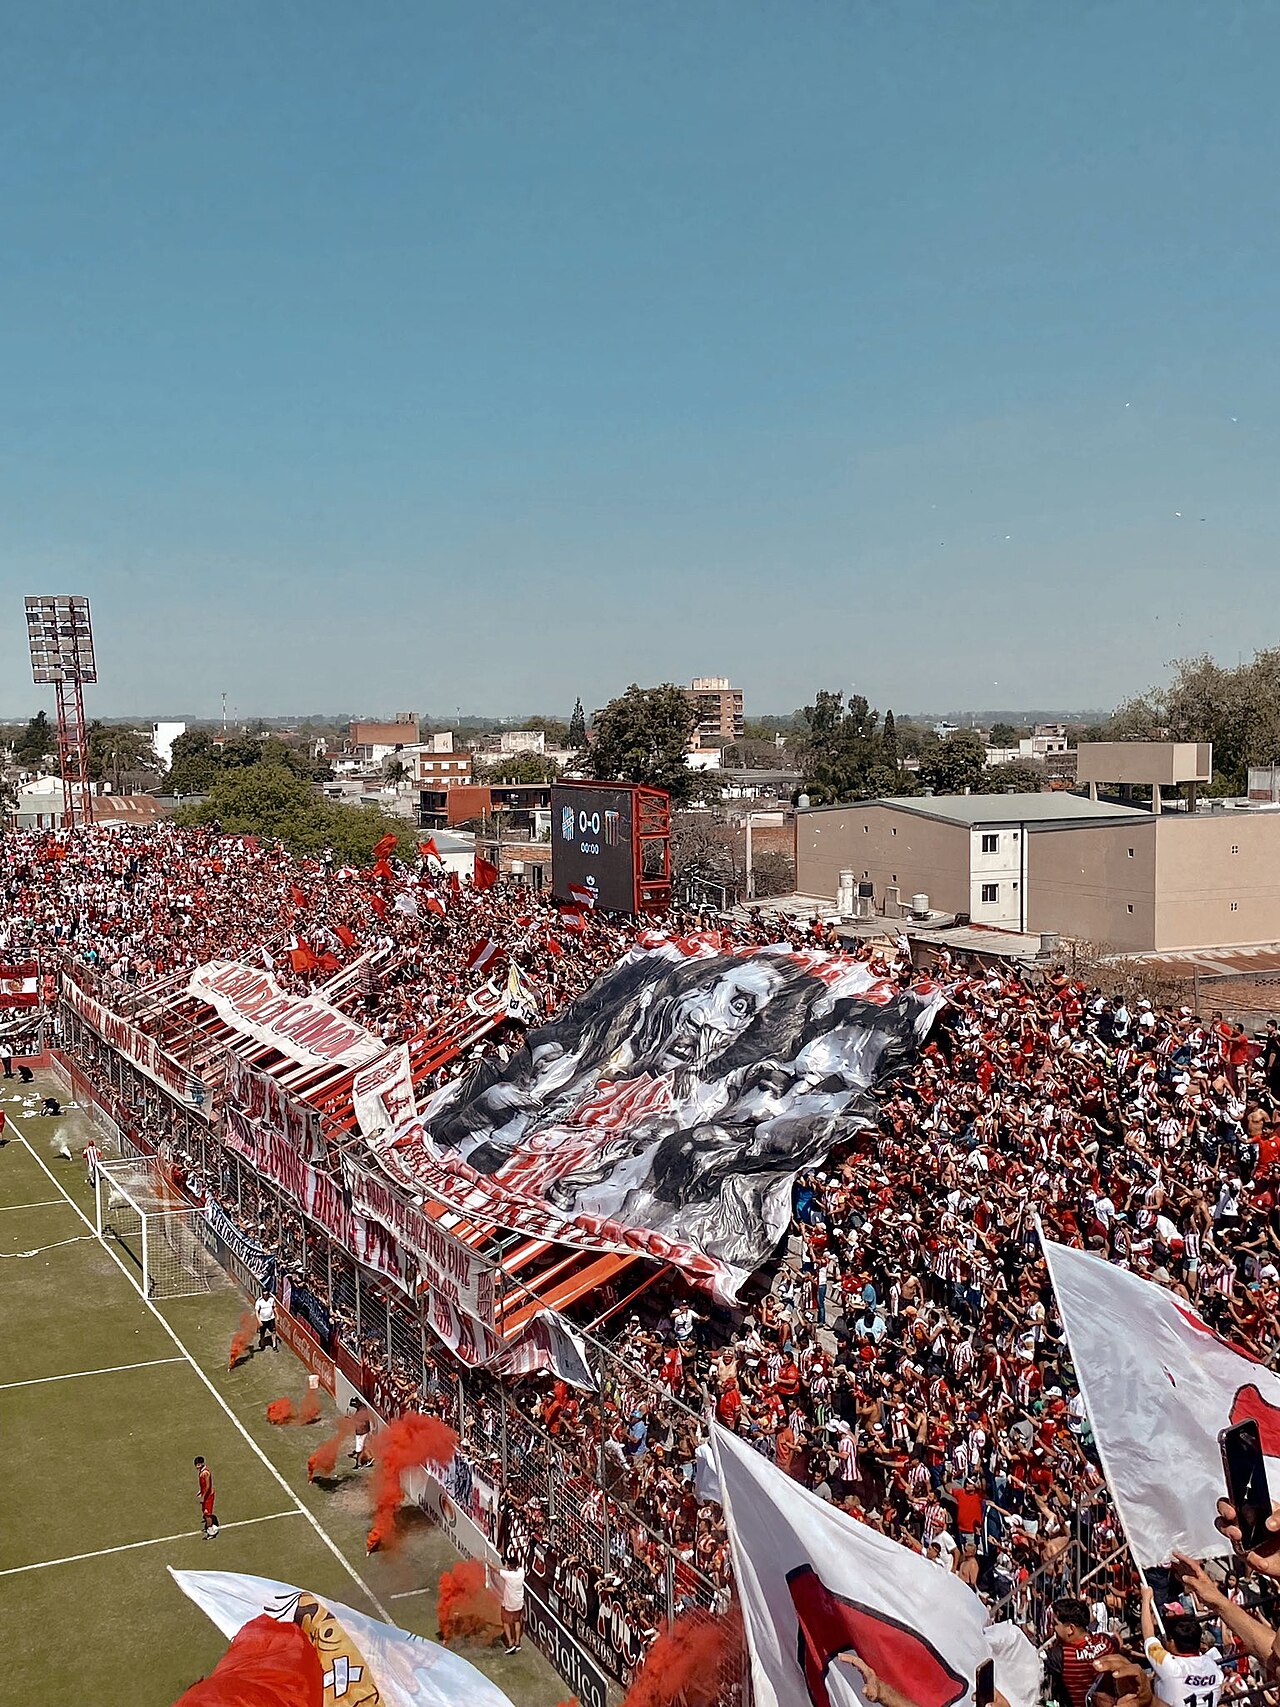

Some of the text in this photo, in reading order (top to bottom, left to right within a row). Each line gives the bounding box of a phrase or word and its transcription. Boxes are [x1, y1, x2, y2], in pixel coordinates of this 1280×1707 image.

[579, 810, 600, 835] 0-0
[581, 841, 599, 855] 00:00
[1185, 1674, 1216, 1687] ESCO
